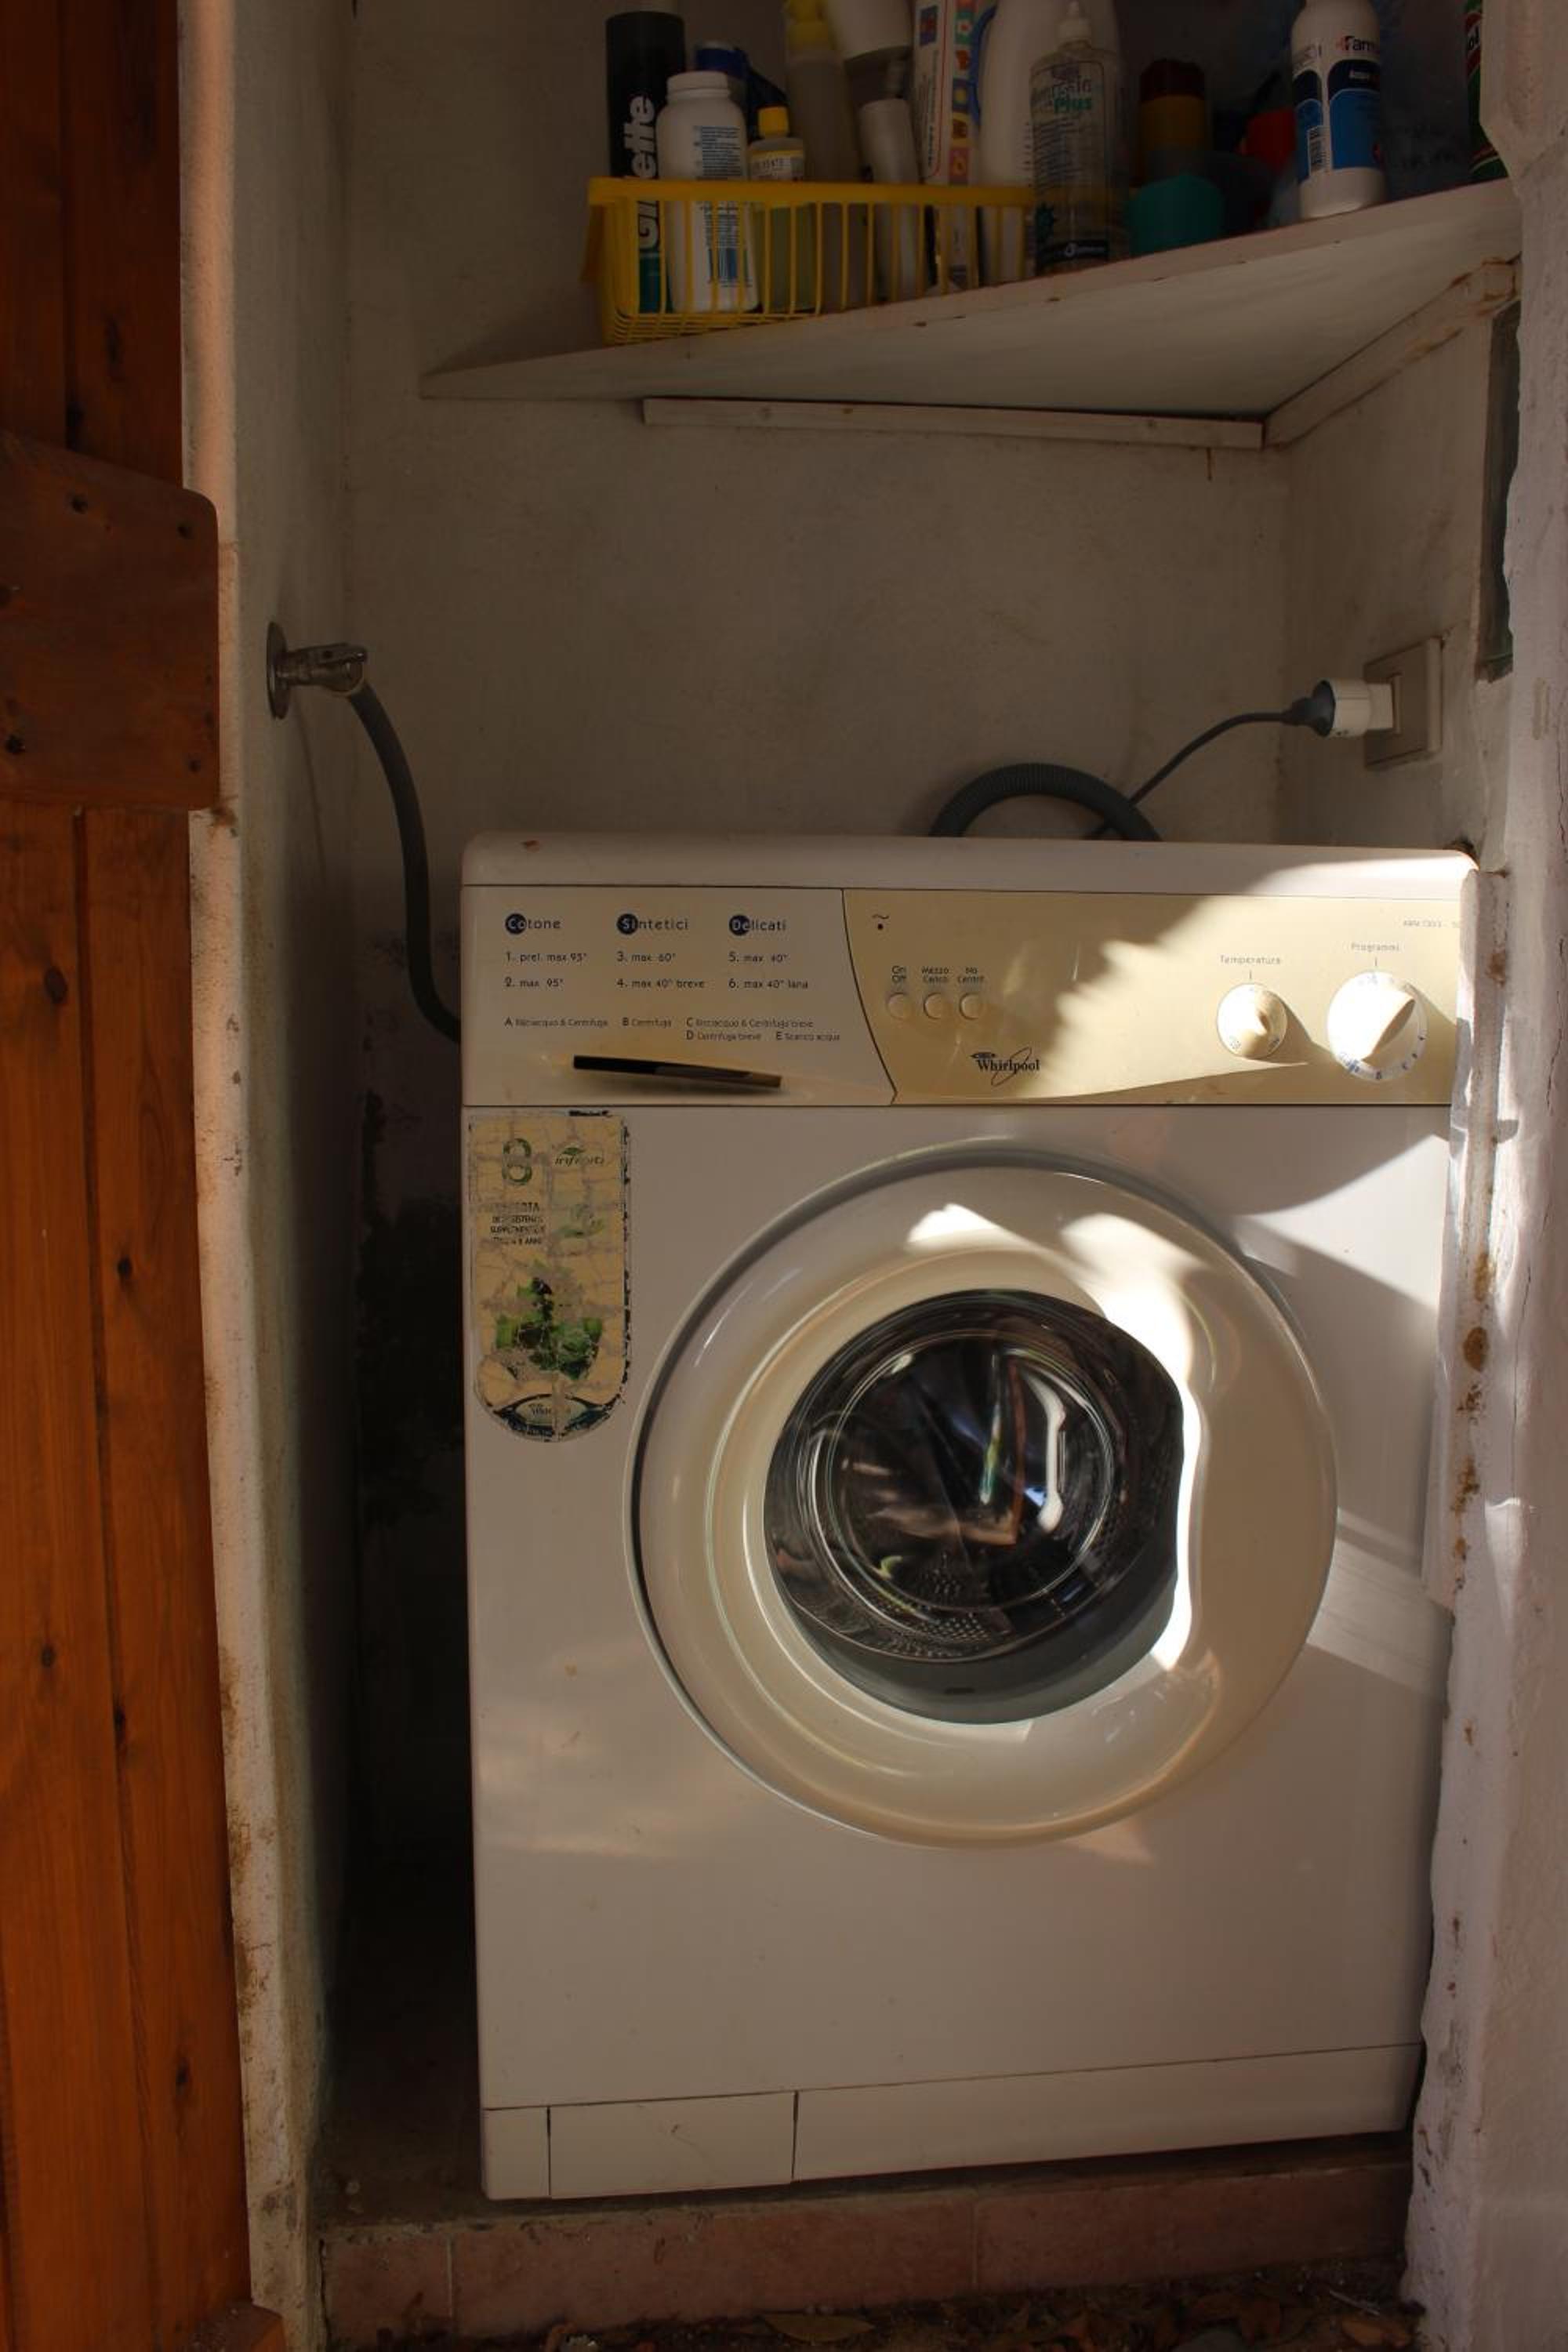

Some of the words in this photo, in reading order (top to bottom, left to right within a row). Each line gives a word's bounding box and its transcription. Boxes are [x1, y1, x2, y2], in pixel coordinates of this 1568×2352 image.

[506, 916, 562, 933] Cotone
[617, 916, 690, 933] Sintetici
[730, 916, 787, 933] Delicati
[1351, 942, 1400, 953] Programmi
[546, 953, 567, 963] max
[616, 951, 627, 962] 3.
[631, 953, 652, 963] max
[728, 951, 739, 963] 5.
[1219, 954, 1281, 967] Temperatura
[616, 978, 628, 989] 4.
[631, 980, 652, 989] max
[677, 978, 705, 989] breve
[728, 978, 739, 989] 6.
[743, 980, 763, 989] max
[505, 1016, 514, 1027] A
[622, 1017, 629, 1027] B
[686, 1017, 693, 1027] C
[686, 1029, 695, 1040] D
[776, 1030, 782, 1040] E
[975, 1058, 1040, 1075] Whirlpool
